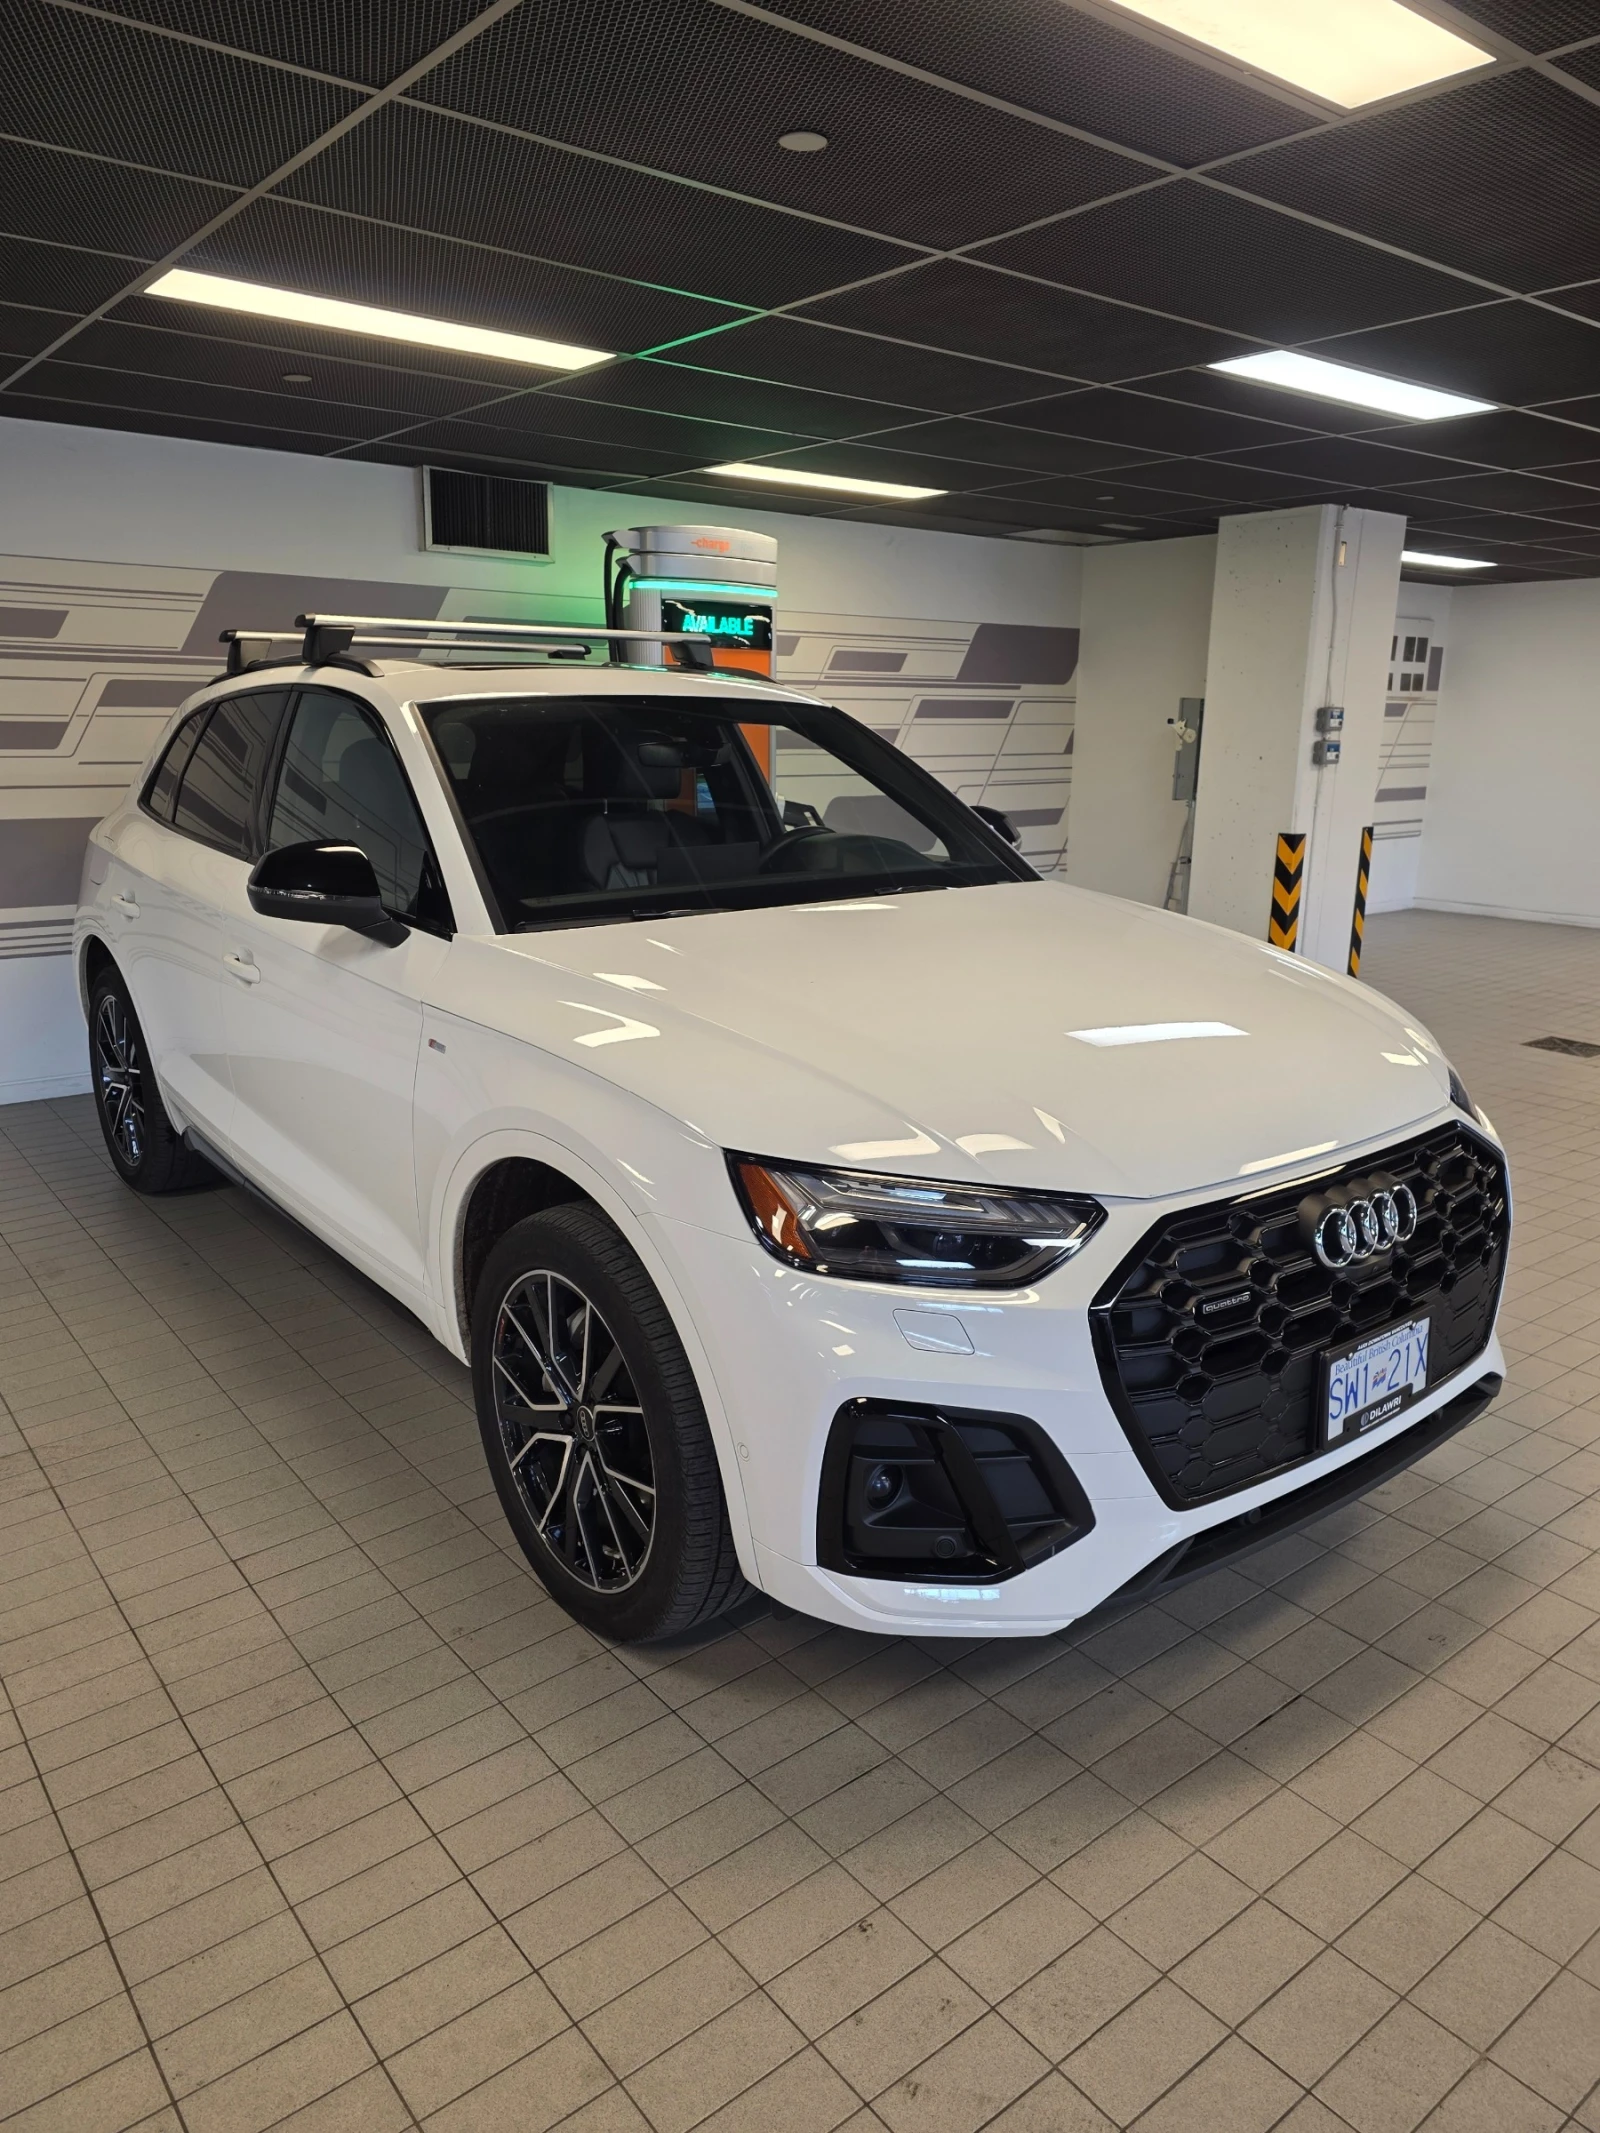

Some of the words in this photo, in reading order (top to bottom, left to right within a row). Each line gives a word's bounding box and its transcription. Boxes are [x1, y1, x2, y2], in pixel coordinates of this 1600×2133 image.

[682, 614, 754, 636] AVAILABLE
[1335, 1349, 1368, 1376] Beautiful
[1368, 1340, 1391, 1360] British
[1391, 1325, 1423, 1348] Columbia
[1369, 1395, 1402, 1421] DILAWRI
